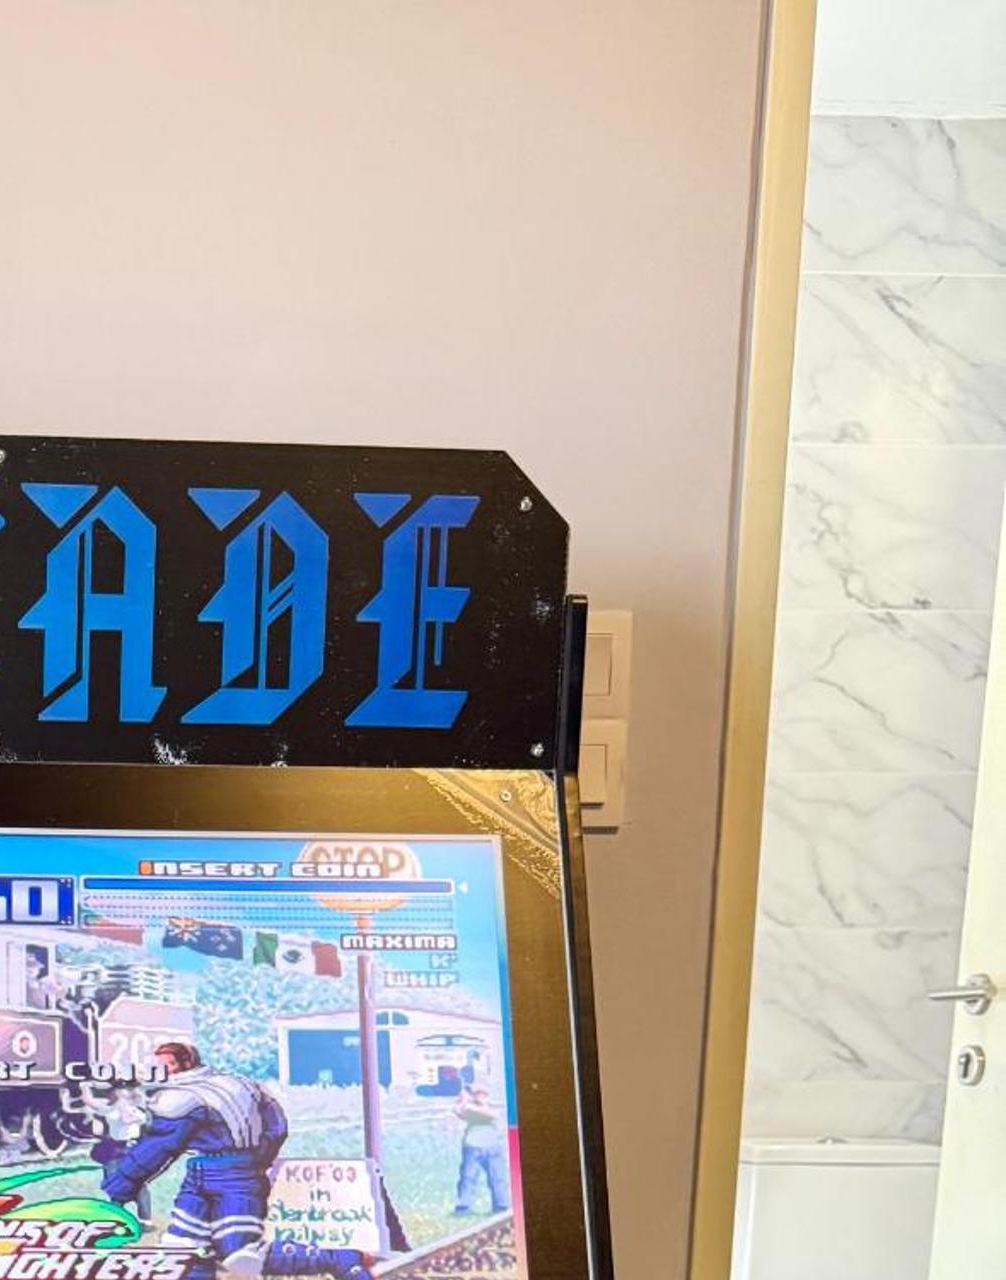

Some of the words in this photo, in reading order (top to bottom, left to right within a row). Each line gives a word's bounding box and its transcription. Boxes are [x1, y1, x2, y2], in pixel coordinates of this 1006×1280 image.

[291, 861, 385, 877] COIN
[341, 934, 457, 951] MAXIMA
[385, 971, 458, 988] WHIP
[41, 1217, 120, 1250] OF
